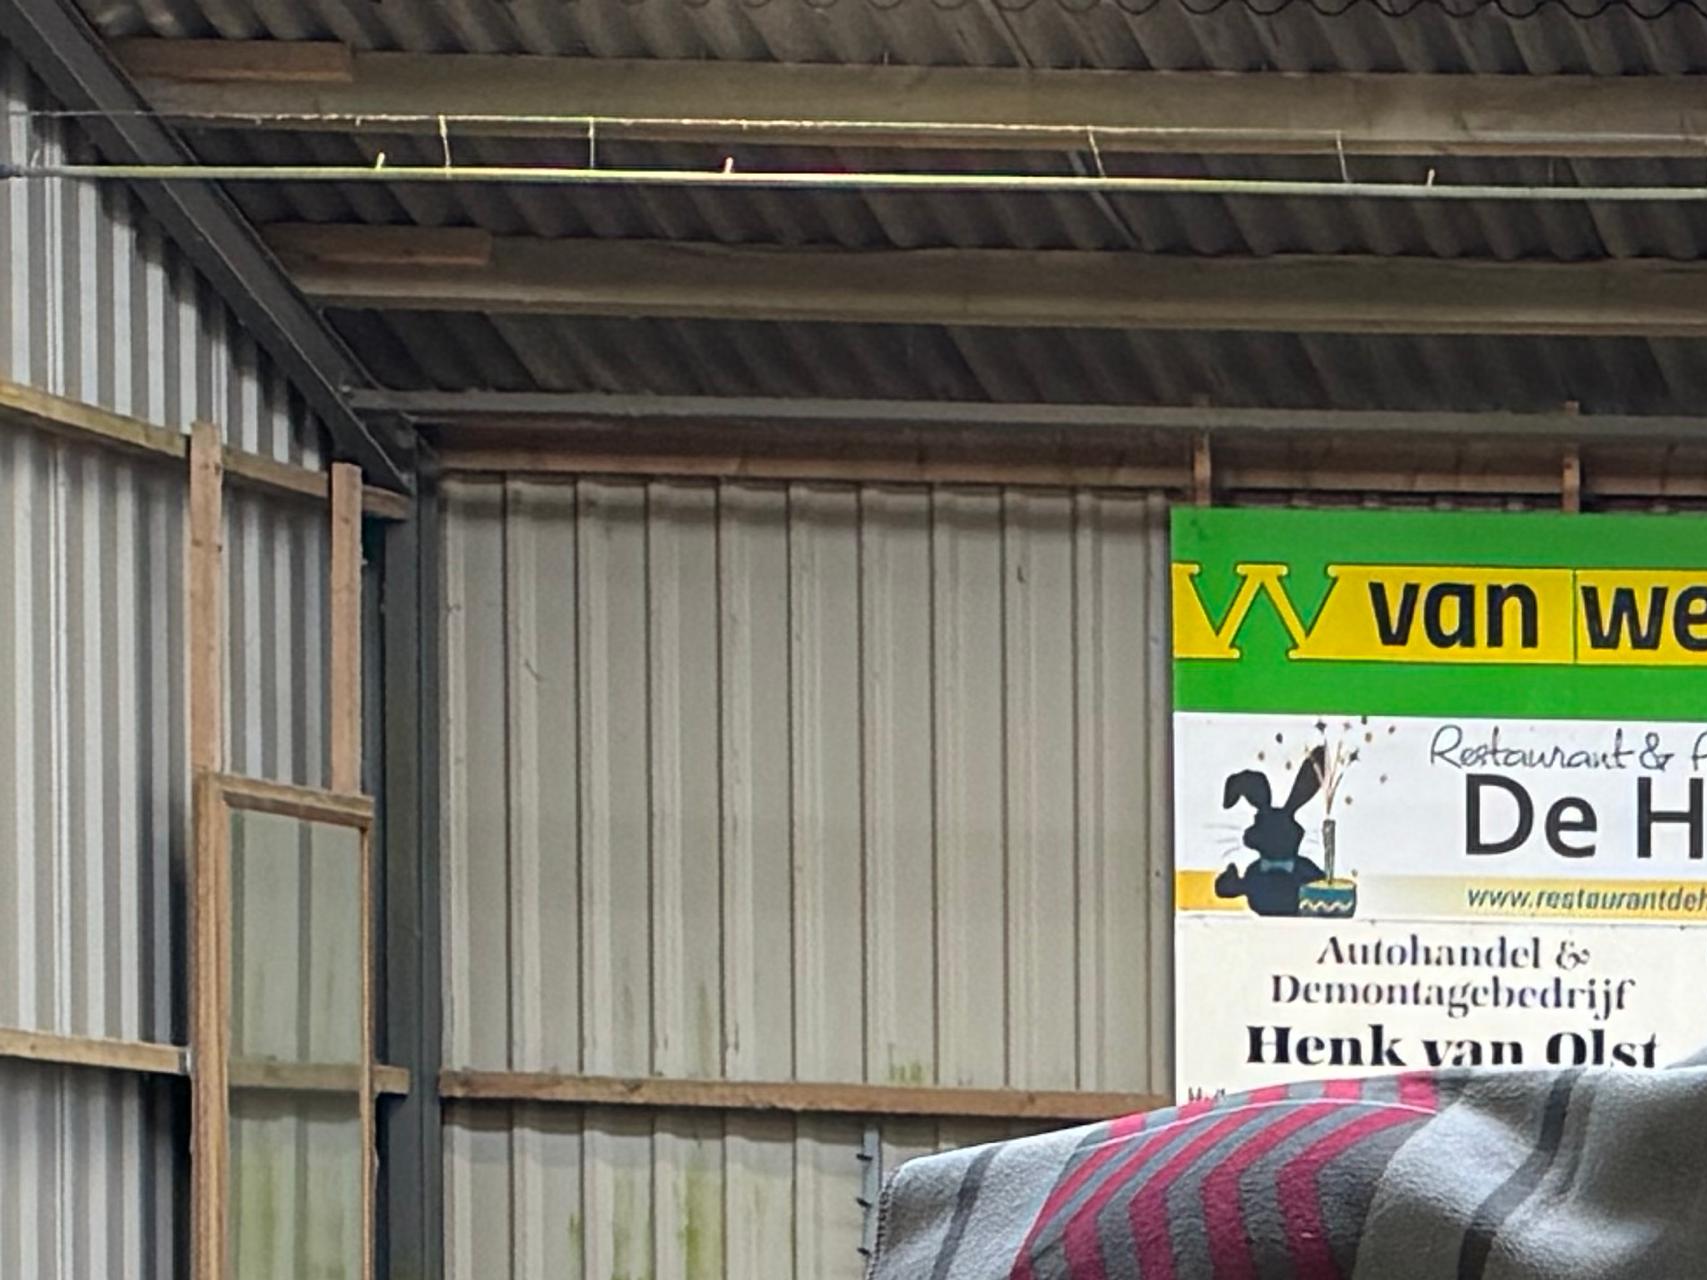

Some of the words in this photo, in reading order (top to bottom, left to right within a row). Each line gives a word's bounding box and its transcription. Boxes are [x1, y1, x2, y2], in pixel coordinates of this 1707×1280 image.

[1368, 581, 1539, 649] van
[1430, 724, 1635, 770] Restaurant
[1640, 731, 1675, 771] &
[1464, 772, 1598, 859] De
[1316, 934, 1542, 969] Autohandel
[1555, 940, 1591, 969] &
[1270, 974, 1637, 1020] Demontagebedrijf
[1246, 1025, 1408, 1066] Henk
[1421, 1038, 1524, 1068] van
[1545, 1028, 1663, 1070] Olst
